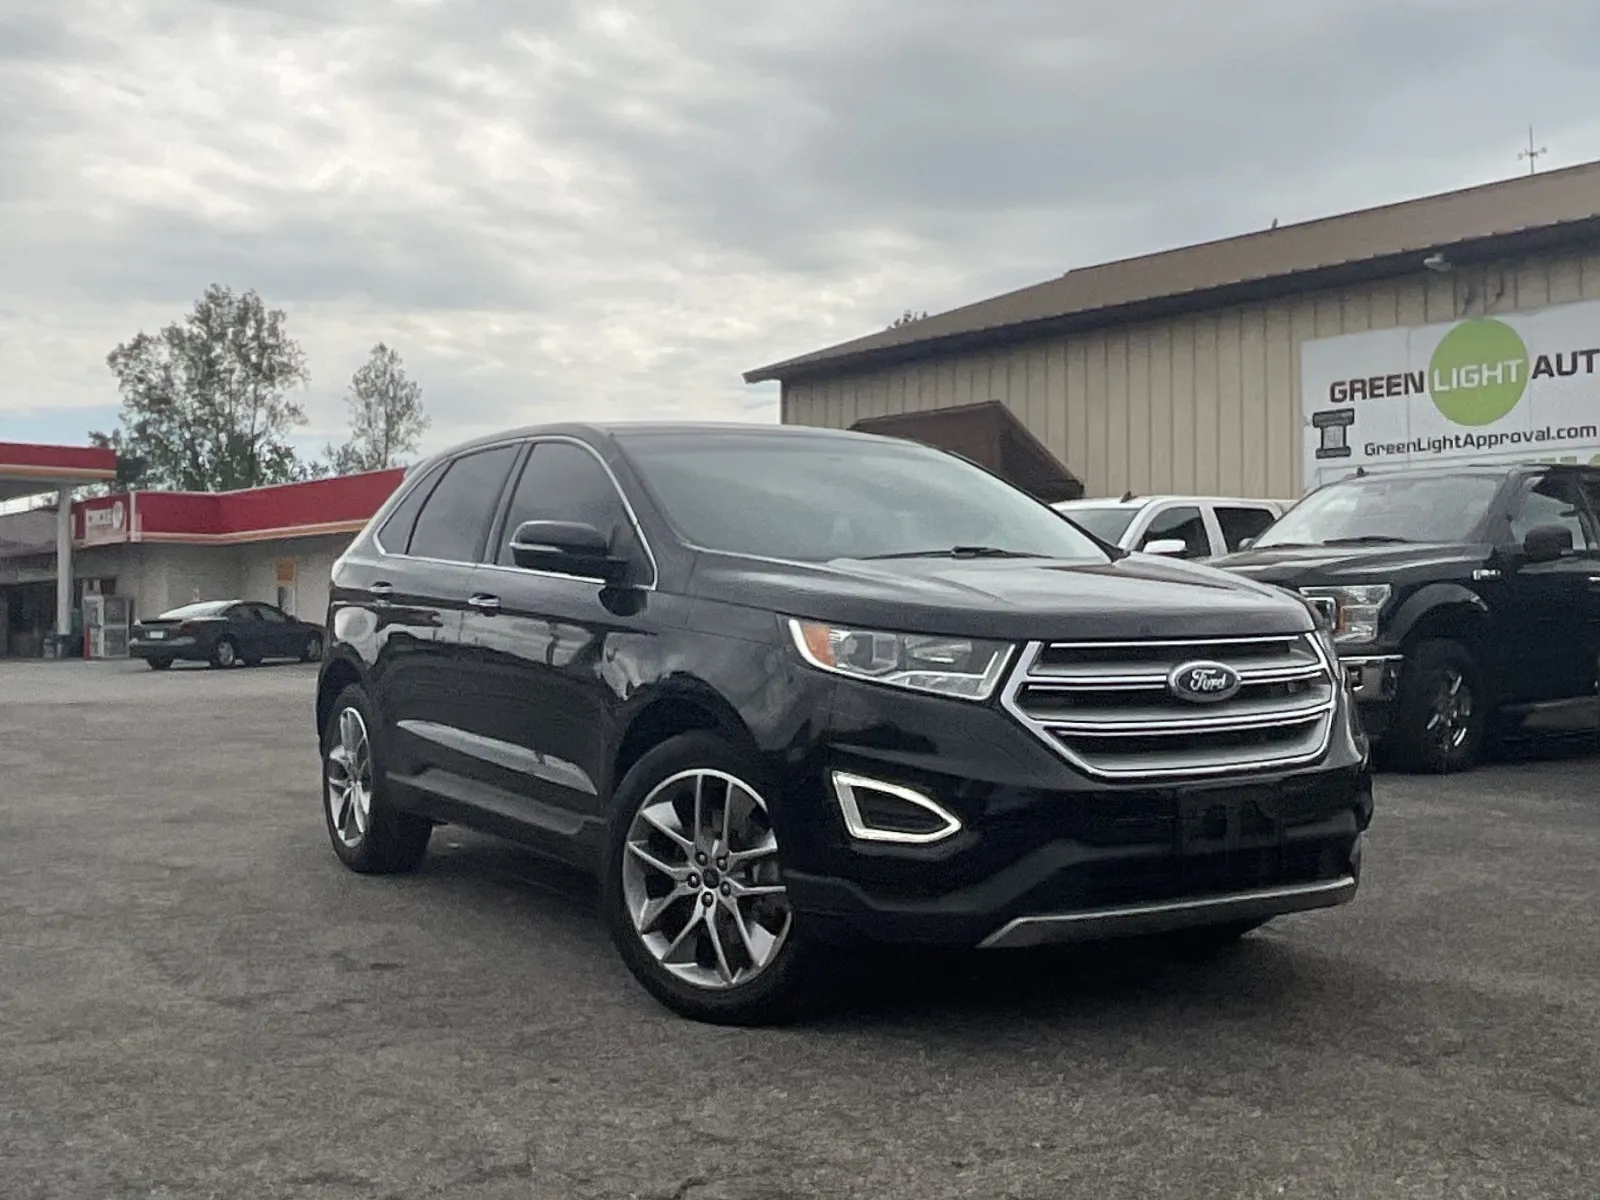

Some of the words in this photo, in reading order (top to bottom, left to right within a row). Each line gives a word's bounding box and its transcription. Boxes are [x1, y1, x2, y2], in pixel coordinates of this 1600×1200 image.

[1329, 370, 1424, 403] GREEN
[1433, 359, 1524, 392] LIGHT
[1363, 425, 1597, 456] GreenLightApproval.com
[1190, 669, 1227, 691] Ford
